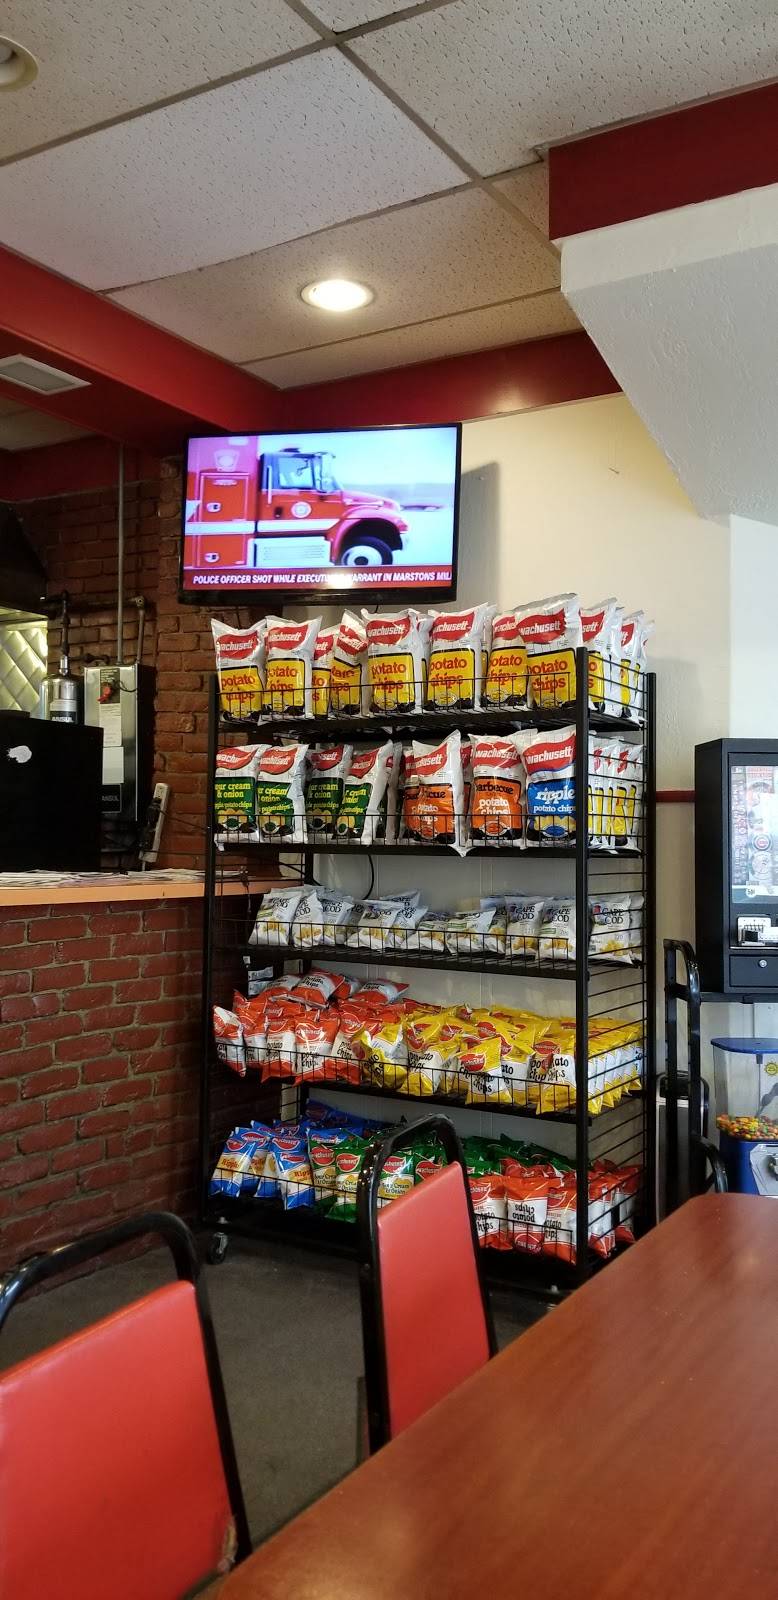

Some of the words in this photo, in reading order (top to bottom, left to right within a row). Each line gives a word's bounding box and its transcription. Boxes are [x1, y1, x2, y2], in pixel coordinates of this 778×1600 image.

[193, 575, 219, 584] POLICE
[219, 575, 251, 584] OFFICER
[252, 574, 272, 583] SHOT
[272, 574, 296, 583] WHILE
[352, 573, 383, 582] ARRANT
[383, 573, 392, 582] IN
[392, 572, 435, 581] MARSTONS
[519, 622, 561, 635] wachusett
[222, 674, 256, 687] potato
[532, 677, 566, 692] chips
[526, 746, 573, 765] wachusett
[224, 789, 244, 798] onion
[535, 785, 575, 804] ripple
[533, 805, 556, 813] potato
[517, 912, 534, 920] COD
[552, 914, 570, 923] COD
[604, 916, 624, 924] COD
[477, 1221, 494, 1232] hips
